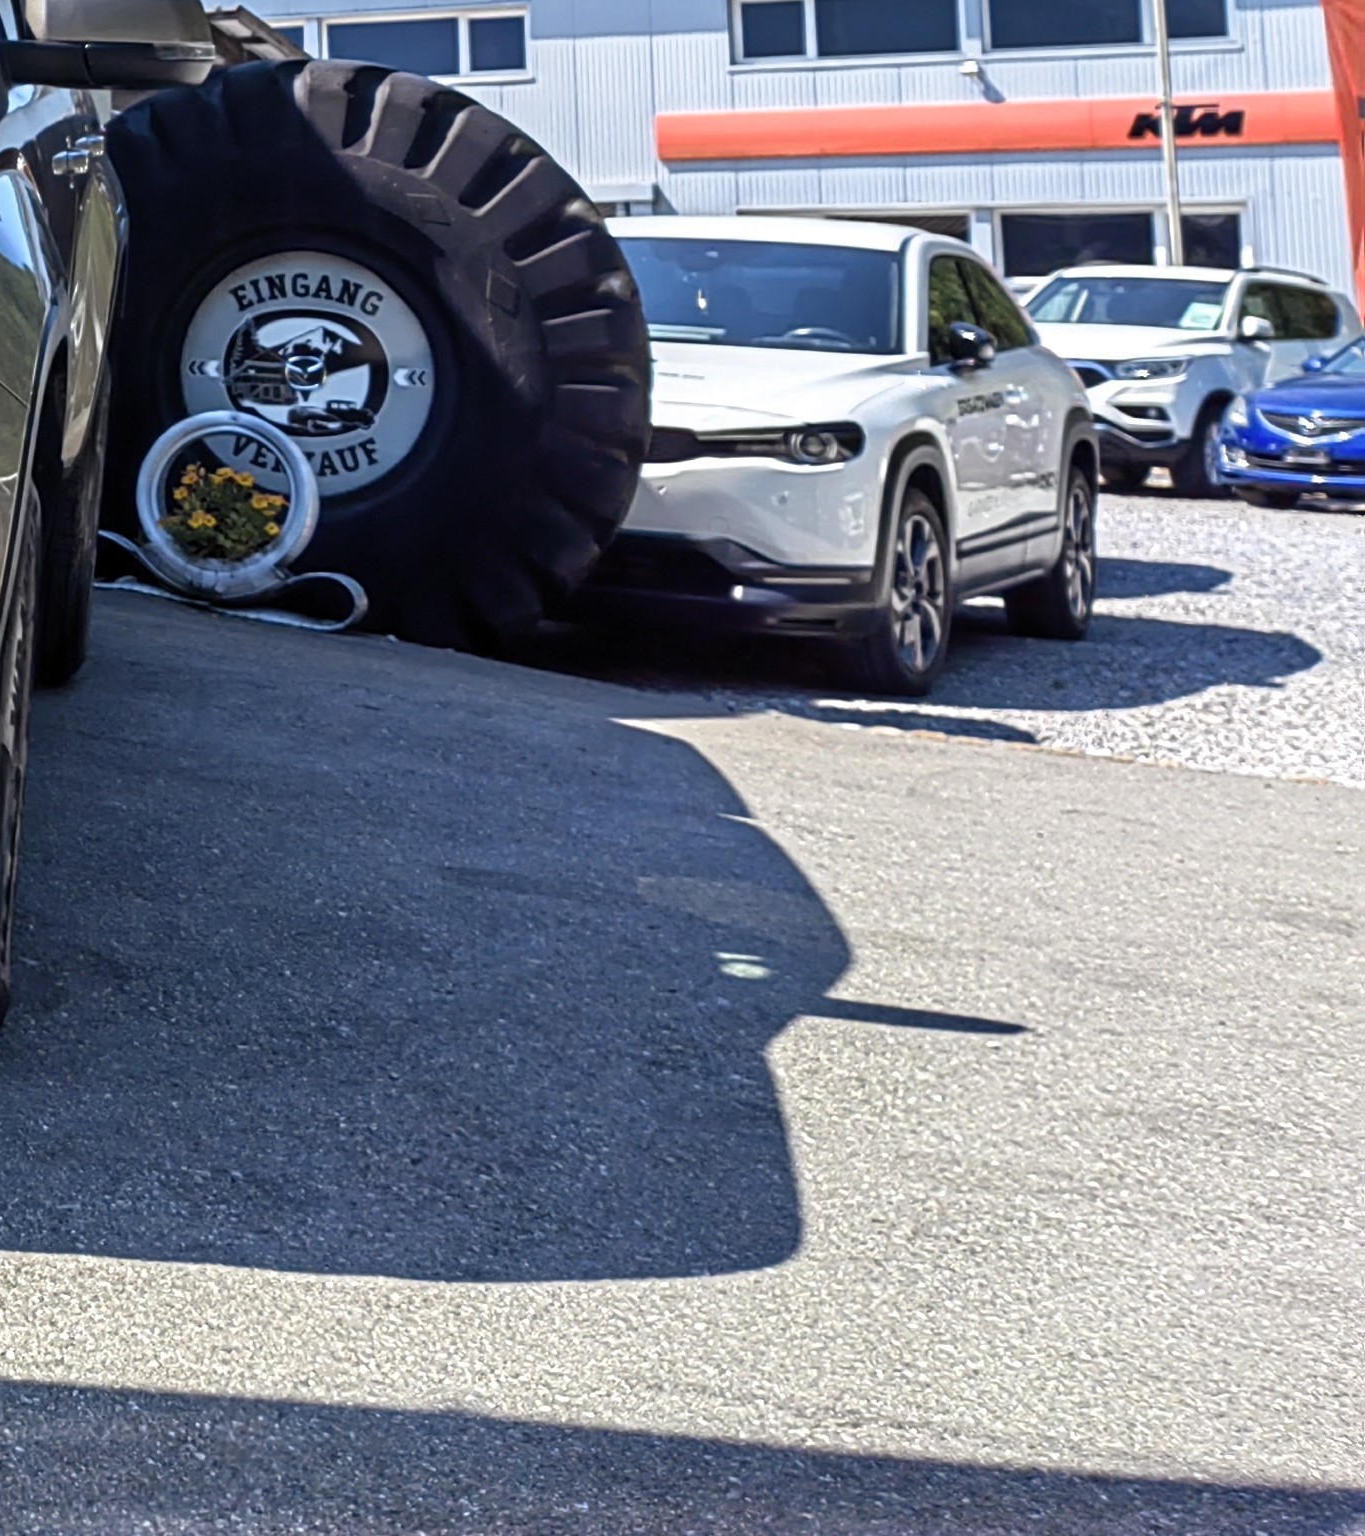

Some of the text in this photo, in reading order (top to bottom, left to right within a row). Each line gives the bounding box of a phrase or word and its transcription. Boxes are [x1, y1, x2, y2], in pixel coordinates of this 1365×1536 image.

[1126, 102, 1245, 139] KTM
[228, 272, 384, 316] EINGANG
[231, 435, 379, 478] VEAUF
